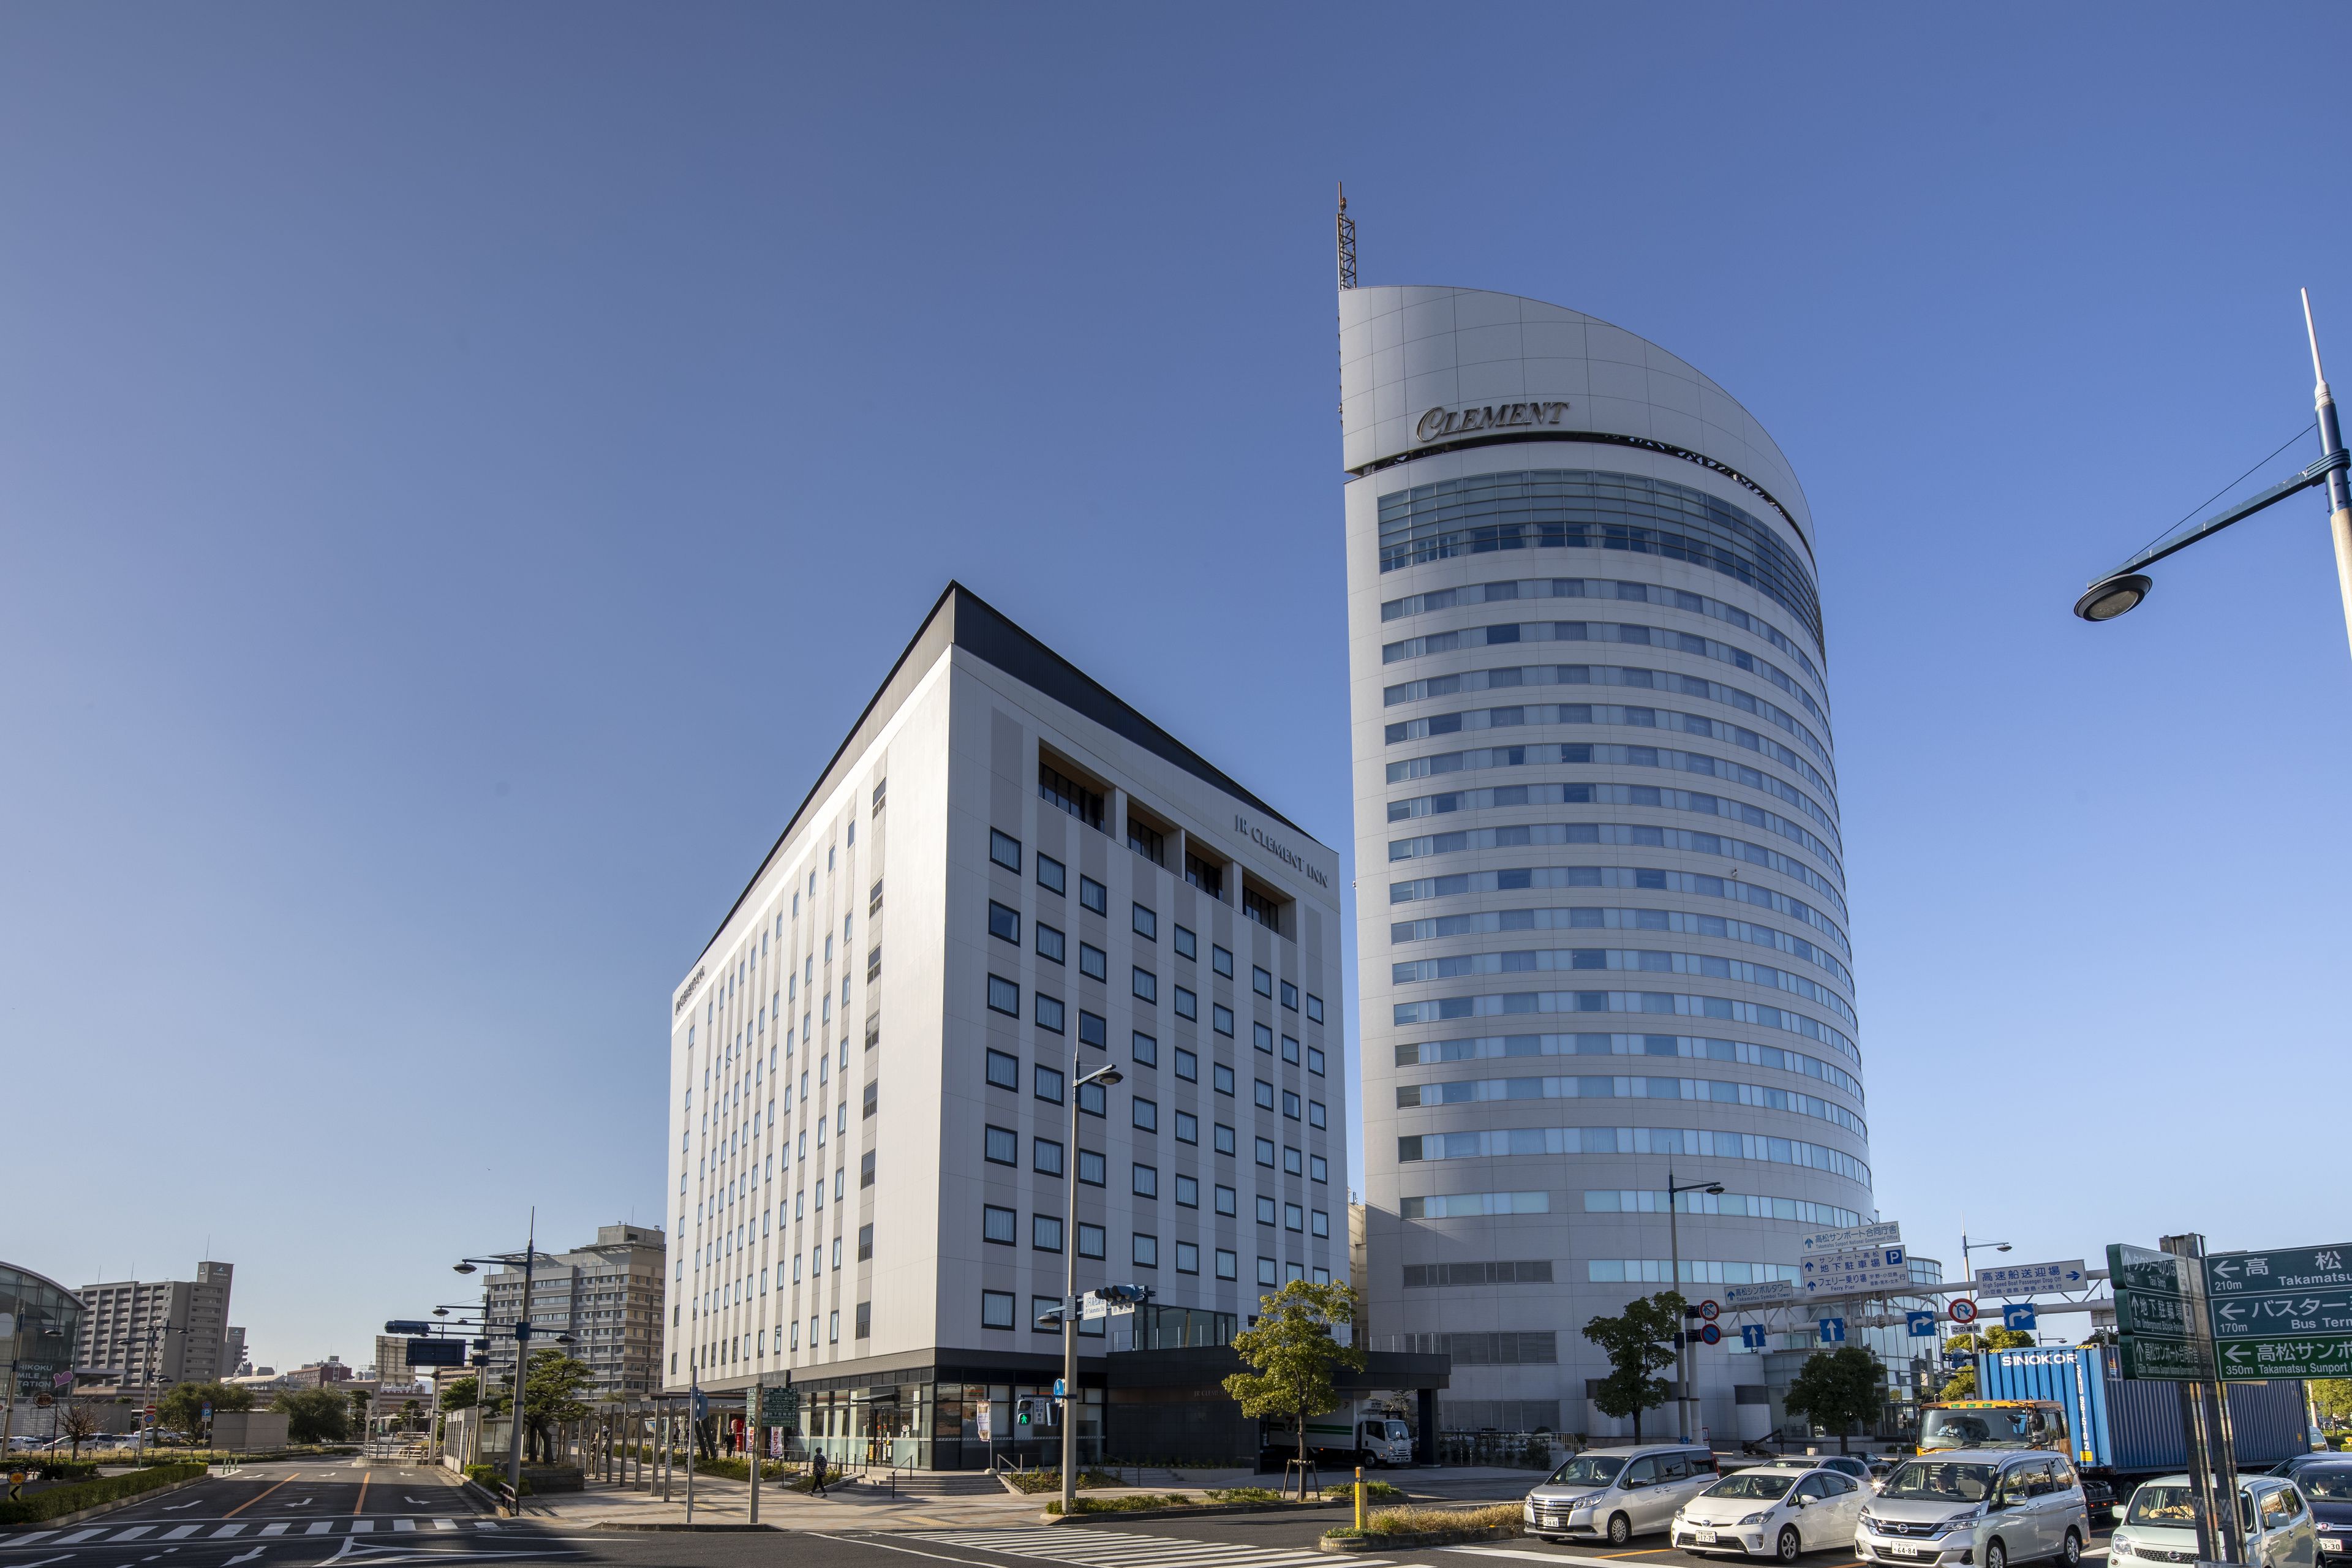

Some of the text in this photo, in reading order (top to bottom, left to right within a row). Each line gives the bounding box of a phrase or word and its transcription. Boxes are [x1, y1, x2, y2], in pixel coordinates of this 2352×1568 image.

[1417, 402, 1570, 442] CLEMENT
[1235, 814, 1328, 888] JR CLEMENT INN
[1815, 1225, 1896, 1243] 高松サンポート合同庁舎
[1819, 1251, 1879, 1264] サンポート高松
[1820, 1259, 1880, 1273] 地下駐車場
[2133, 1254, 2177, 1277] タクシーのりば
[1818, 1274, 1867, 1287] フェリー乗り場
[1982, 1265, 2060, 1282] 高速船送迎場
[2148, 1275, 2157, 1286] Taxi
[2157, 1276, 2166, 1289] Stop
[2215, 1281, 2242, 1291] 210m
[1736, 1284, 1790, 1296] 高松シンボルタワー
[2139, 1297, 2183, 1320] 地下駐輪場
[2252, 1295, 2352, 1317] バスター
[2142, 1319, 2162, 1333] Underground
[2162, 1321, 2173, 1332] Bicycle
[2173, 1322, 2185, 1334] Parking
[2220, 1323, 2248, 1333] 170m
[2291, 1319, 2316, 1330] Bus
[2002, 1354, 2078, 1366] SINOKOR
[2144, 1343, 2198, 1364] 高松サンポート合同庁舎
[2226, 1365, 2253, 1376] 350m
[2258, 1365, 2306, 1375] Takamatsu
[2310, 1362, 2348, 1374] Sunport
